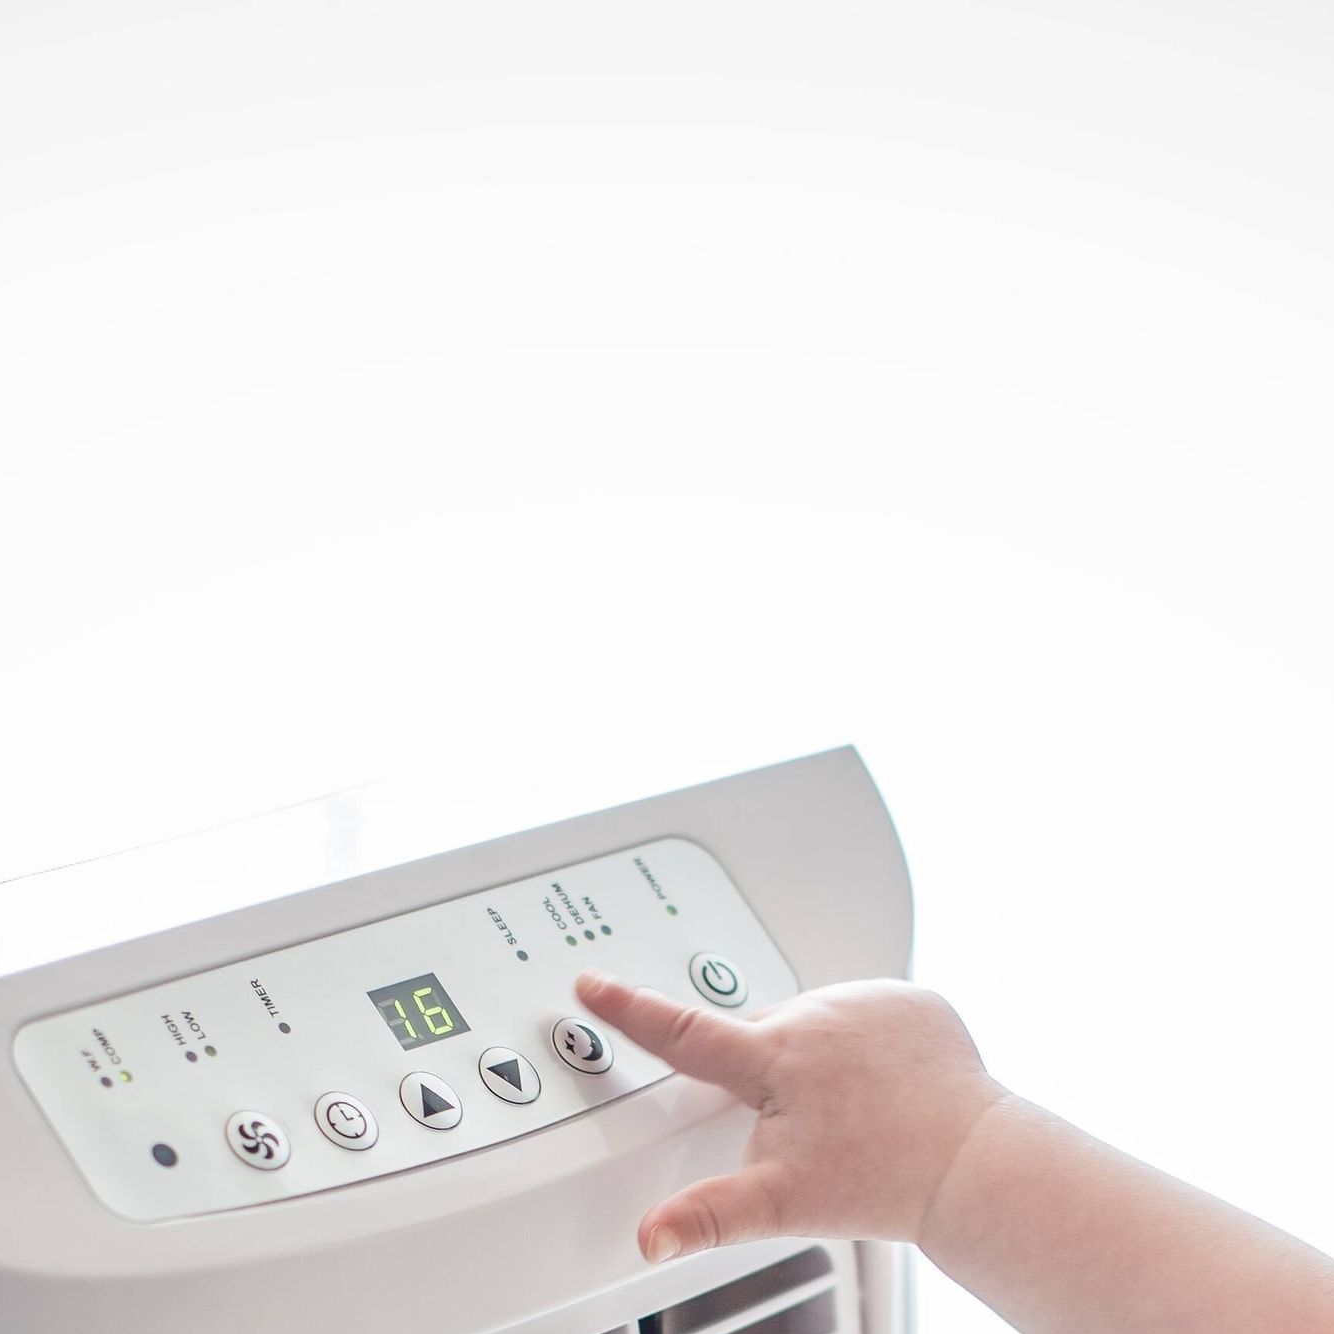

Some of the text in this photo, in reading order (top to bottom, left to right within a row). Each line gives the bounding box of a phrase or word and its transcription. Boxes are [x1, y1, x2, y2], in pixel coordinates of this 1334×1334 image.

[634, 857, 667, 901] POWER
[541, 896, 567, 930] COOL
[551, 882, 585, 926] DEHUM
[581, 896, 602, 920] FAN
[486, 907, 517, 946] SLEEP
[250, 978, 279, 1017] TIMER
[394, 987, 454, 1039] 16
[161, 1014, 187, 1046] HIGH
[181, 1010, 207, 1041] LOW
[92, 1027, 122, 1065] COMP
